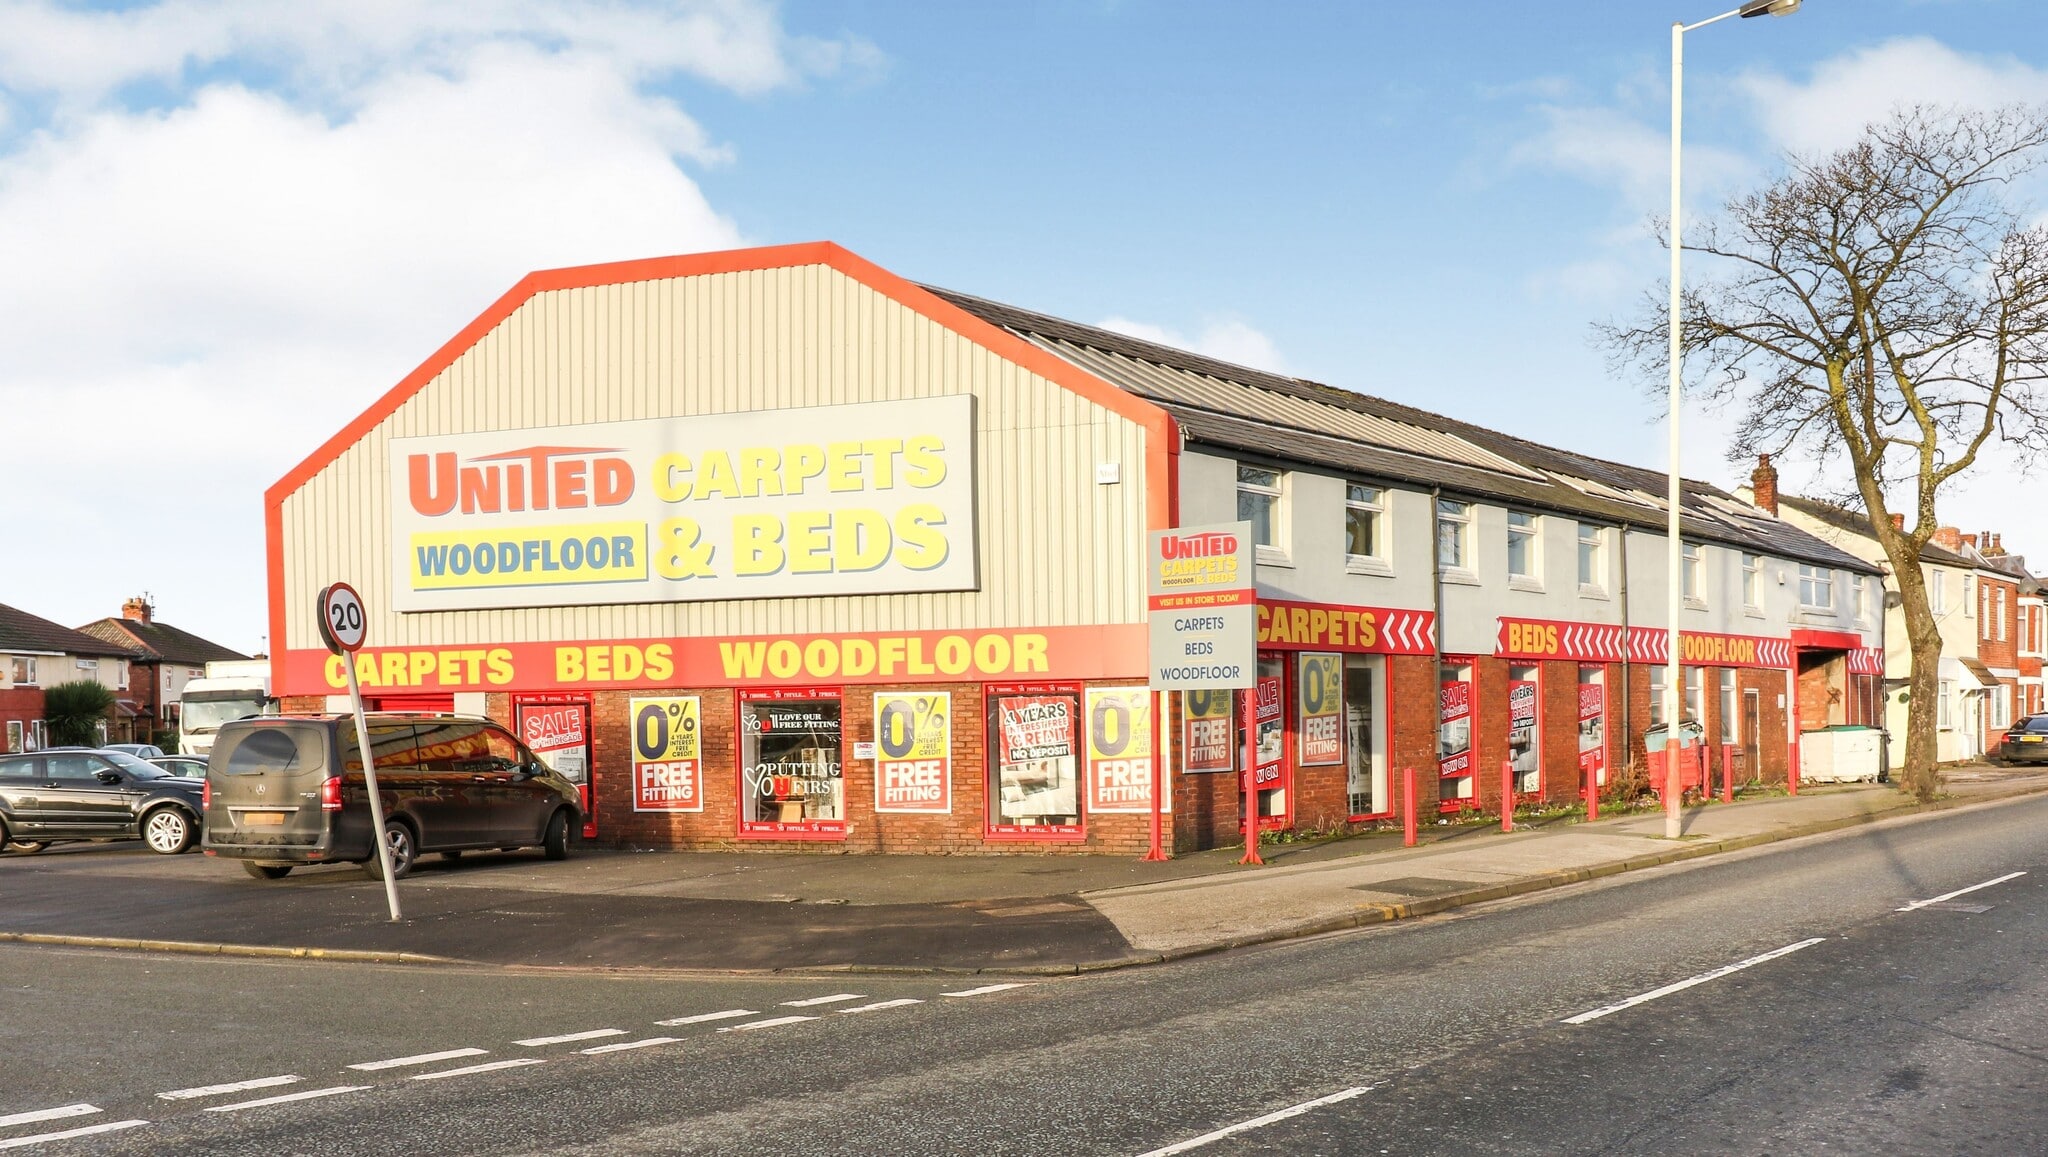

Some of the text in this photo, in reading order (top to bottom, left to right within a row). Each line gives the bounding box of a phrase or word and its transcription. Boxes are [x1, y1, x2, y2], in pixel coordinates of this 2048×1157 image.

[652, 434, 948, 503] CARPETS
[408, 446, 636, 517] UNITED
[653, 504, 951, 582] & BEDS
[1161, 532, 1238, 560] UNITED
[417, 536, 635, 577] WOODFLOOR
[1161, 556, 1238, 577] CARPETS
[1162, 577, 1194, 585] WOODFLOOR
[1207, 572, 1237, 584] BEDS
[1159, 594, 1239, 607] VISIT US IN STORE TODAY
[332, 603, 361, 631] 20
[1174, 616, 1224, 632] CARPETS
[1256, 604, 1376, 648] CARPETS
[1185, 641, 1213, 655] BEDS
[1509, 622, 1558, 655] BEDS
[324, 633, 1049, 689] CARPETS BEDS WOODFLOOR
[1160, 665, 1240, 681] WOODFLOOR
[1304, 657, 1339, 714] 0%
[1441, 684, 1468, 711] SALE
[1580, 686, 1601, 709] SALE
[1019, 703, 1066, 723] YEARS
[1048, 717, 1067, 726] FREE
[526, 708, 581, 741] SALE
[637, 702, 695, 760] 0%
[779, 720, 839, 729] FREE FITTING
[880, 697, 945, 759] 0%
[1190, 719, 1226, 747] FREE
[1306, 715, 1337, 742] FREE
[554, 734, 582, 745] DECADE
[1010, 727, 1067, 747] CREDIT
[1012, 746, 1068, 759] NO DEPOSIT
[1190, 745, 1226, 762] FITTING
[1306, 739, 1337, 756] FITTING
[641, 761, 693, 788] FREE
[766, 762, 840, 776] PUTTING
[885, 760, 941, 788] FREE
[1265, 765, 1278, 780] ON
[1442, 756, 1468, 776] NOW ON
[642, 785, 693, 802] FITTING
[792, 780, 838, 794] FIRST
[885, 785, 941, 802] FITTING
